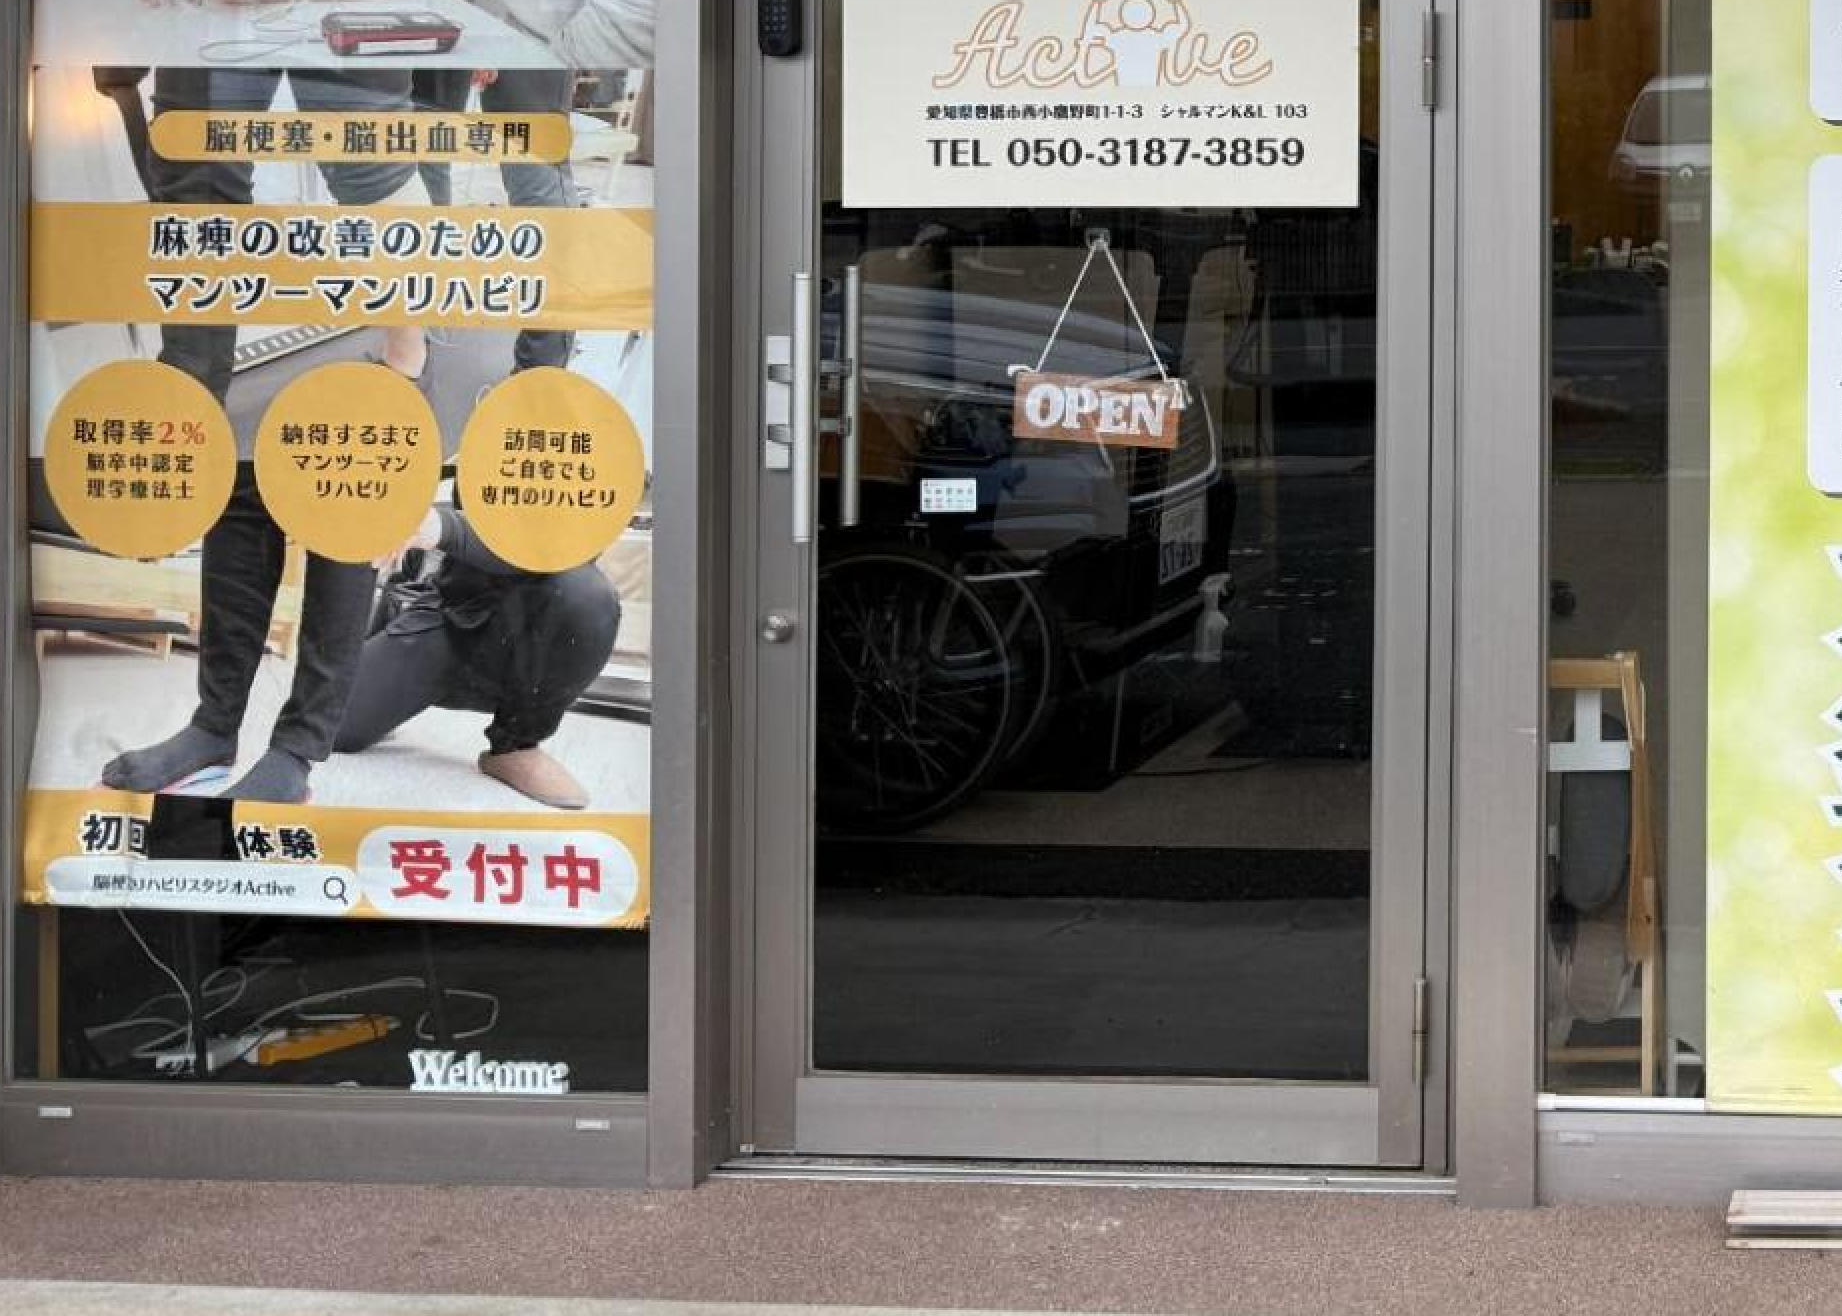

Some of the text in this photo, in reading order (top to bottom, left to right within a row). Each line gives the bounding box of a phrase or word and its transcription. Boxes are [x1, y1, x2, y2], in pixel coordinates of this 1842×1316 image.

[1275, 104, 1308, 119] 103
[204, 120, 532, 154] 脳梗塞・脳出血専門
[926, 138, 1305, 167] TEL 050-3187-3859
[151, 218, 543, 259] 麻痺の改善のための
[149, 275, 544, 313] マンツーマンリハビリ
[1025, 383, 1165, 436] OPEN
[73, 420, 206, 445] 取得率2%
[281, 425, 420, 447] 納得するまで
[503, 430, 592, 455] 訪問可能
[86, 453, 195, 474] 脳卒中認定
[293, 454, 410, 472] マンツーマン
[499, 459, 596, 481] ご自宅でも
[86, 480, 195, 500] 理学療法士
[316, 480, 389, 500] リハビリ
[481, 485, 617, 510] 専門のリハビリ
[390, 840, 601, 907] 受付中
[408, 1048, 569, 1095] Welcome
